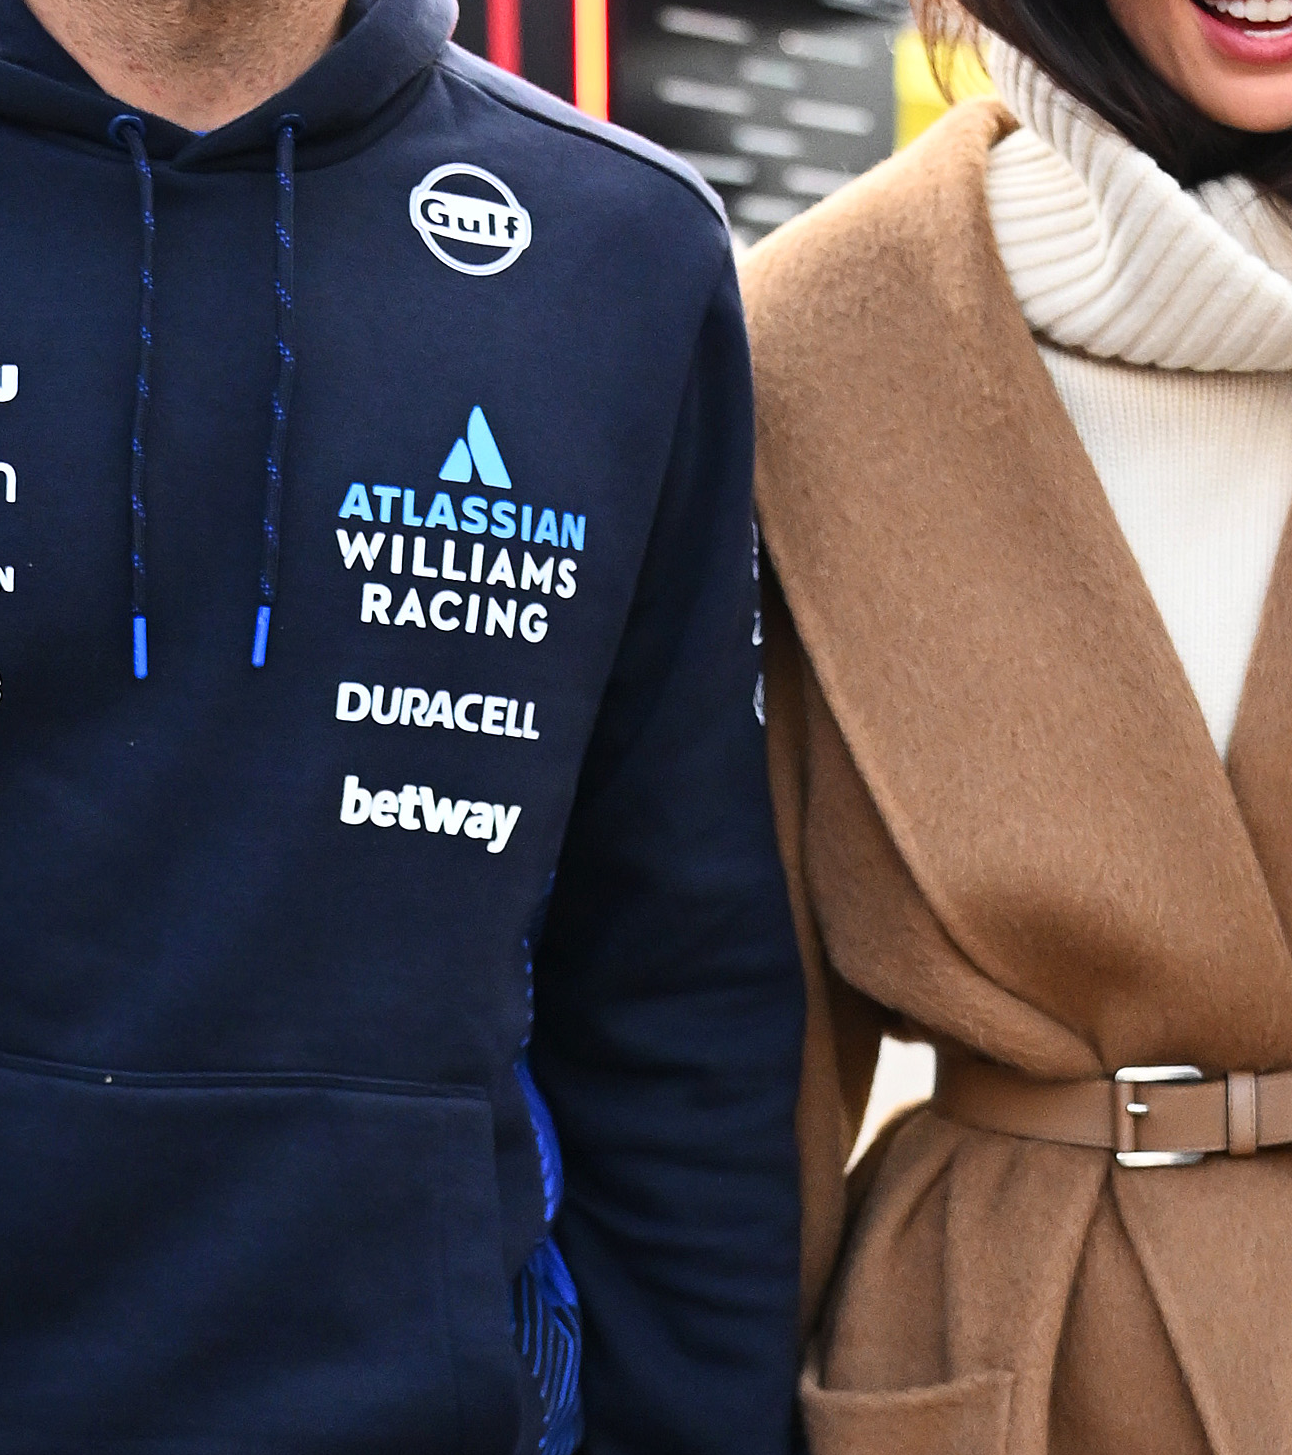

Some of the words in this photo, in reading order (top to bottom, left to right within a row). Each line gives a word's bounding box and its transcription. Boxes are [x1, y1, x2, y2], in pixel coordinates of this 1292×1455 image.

[420, 198, 519, 240] Gulf
[339, 483, 587, 550] ATLASSIAN
[336, 528, 578, 599] WILLIAMS
[360, 582, 549, 644] RACING
[335, 682, 540, 740] DURACELL
[339, 775, 522, 854] betway
